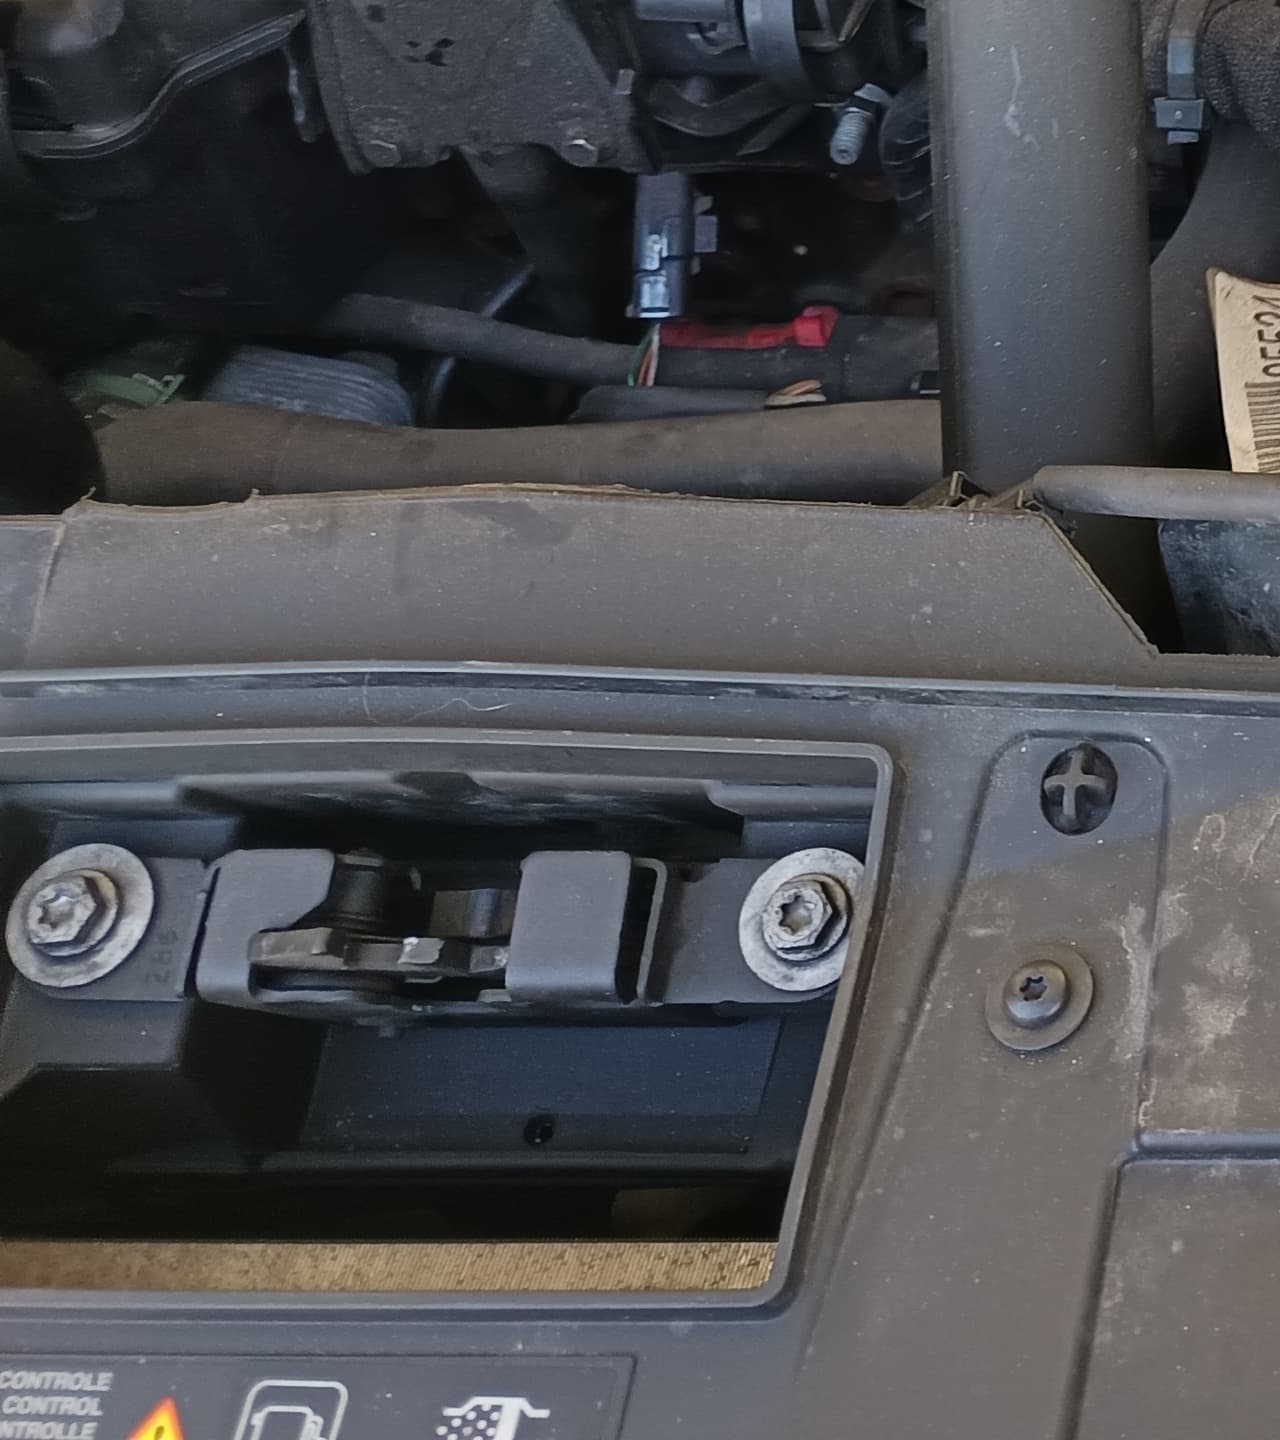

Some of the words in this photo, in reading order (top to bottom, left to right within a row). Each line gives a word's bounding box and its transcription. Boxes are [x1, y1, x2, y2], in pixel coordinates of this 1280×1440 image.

[0, 1371, 114, 1391] CONTROLE
[2, 1395, 104, 1416] CONTROL
[0, 1421, 98, 1440] NTROLLE
